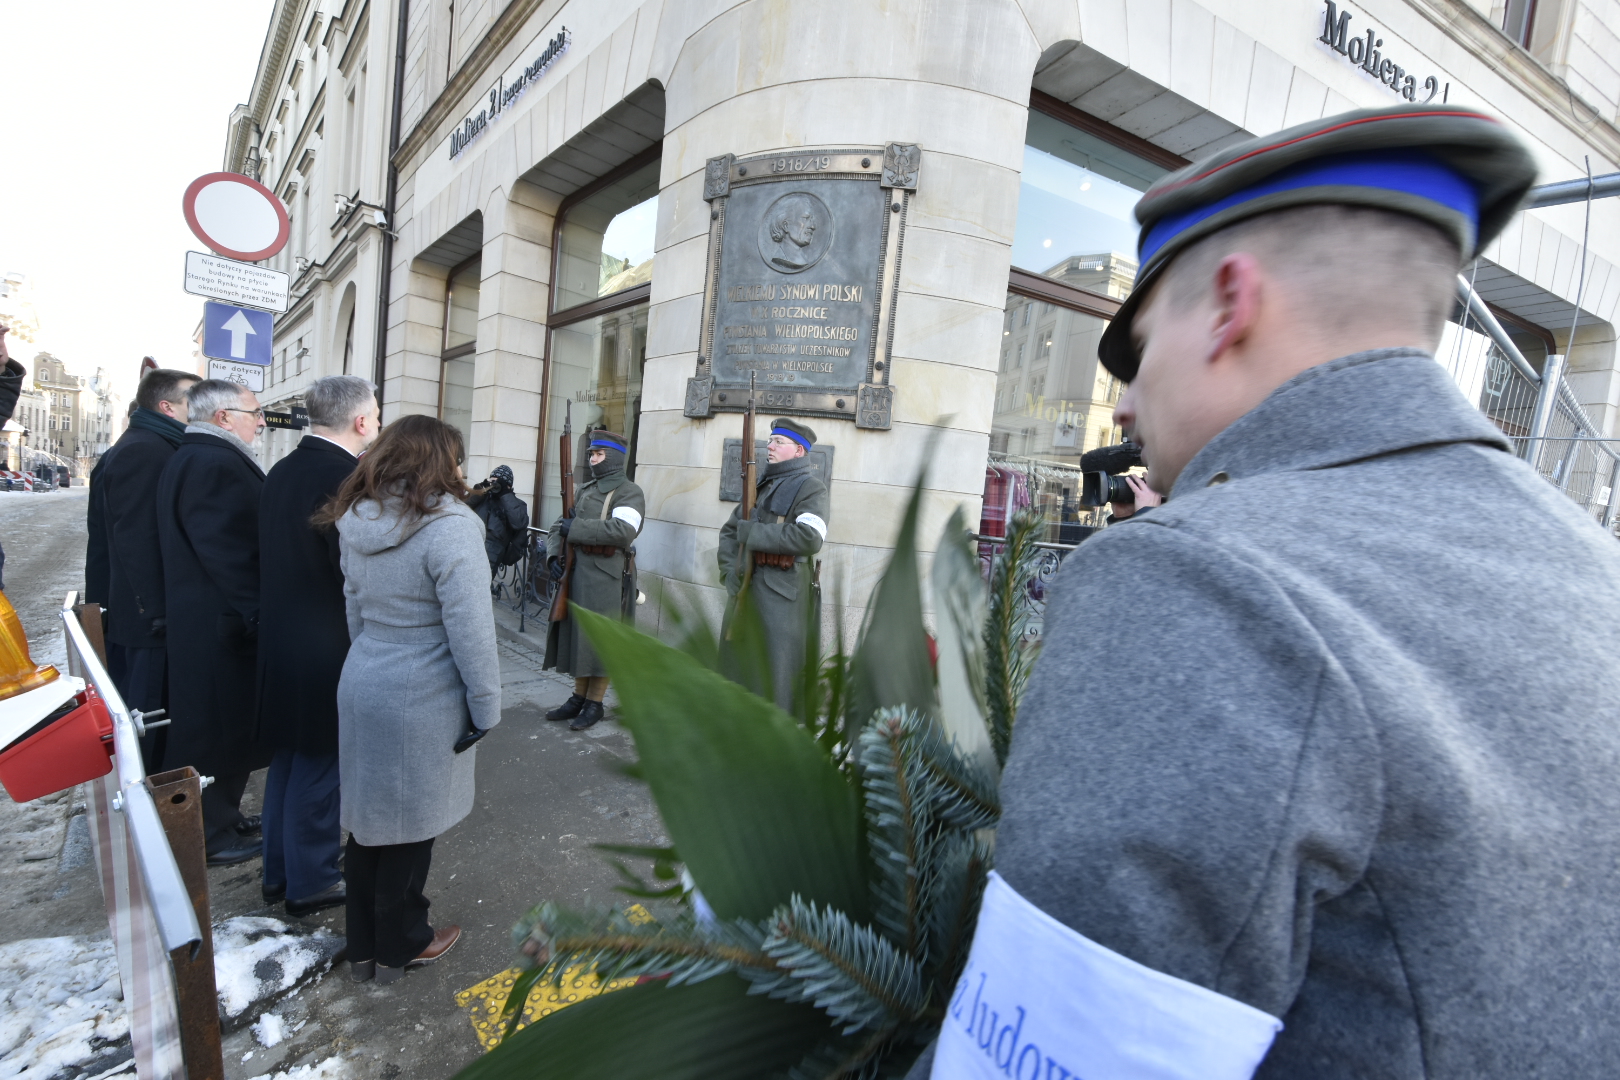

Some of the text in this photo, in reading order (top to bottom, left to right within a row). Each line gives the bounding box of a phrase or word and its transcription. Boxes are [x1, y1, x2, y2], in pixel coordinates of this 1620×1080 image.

[1320, 0, 1438, 104] Moliera 2
[449, 109, 486, 160] Moliera
[489, 89, 496, 120] 2
[771, 156, 831, 172] 1918/19
[201, 258, 214, 267] Nie
[216, 262, 242, 274] dotyczy
[187, 272, 215, 284] Starego
[217, 278, 239, 289] Rynku
[251, 286, 287, 299] warunkach
[208, 268, 269, 287] budowy na płycie
[241, 292, 259, 301] przez
[261, 296, 277, 304] ZDM
[727, 284, 863, 302] WIELKIEMU SYNOWI POLSKI
[761, 306, 769, 319] X
[771, 306, 829, 319] ROCZNICE
[724, 324, 858, 341] POWSTANIA WIELKOPOLSKIEGO
[212, 362, 262, 375] Nie dotyczy
[782, 361, 834, 373] WIELKOPOLSCE
[760, 393, 793, 407] 1928
